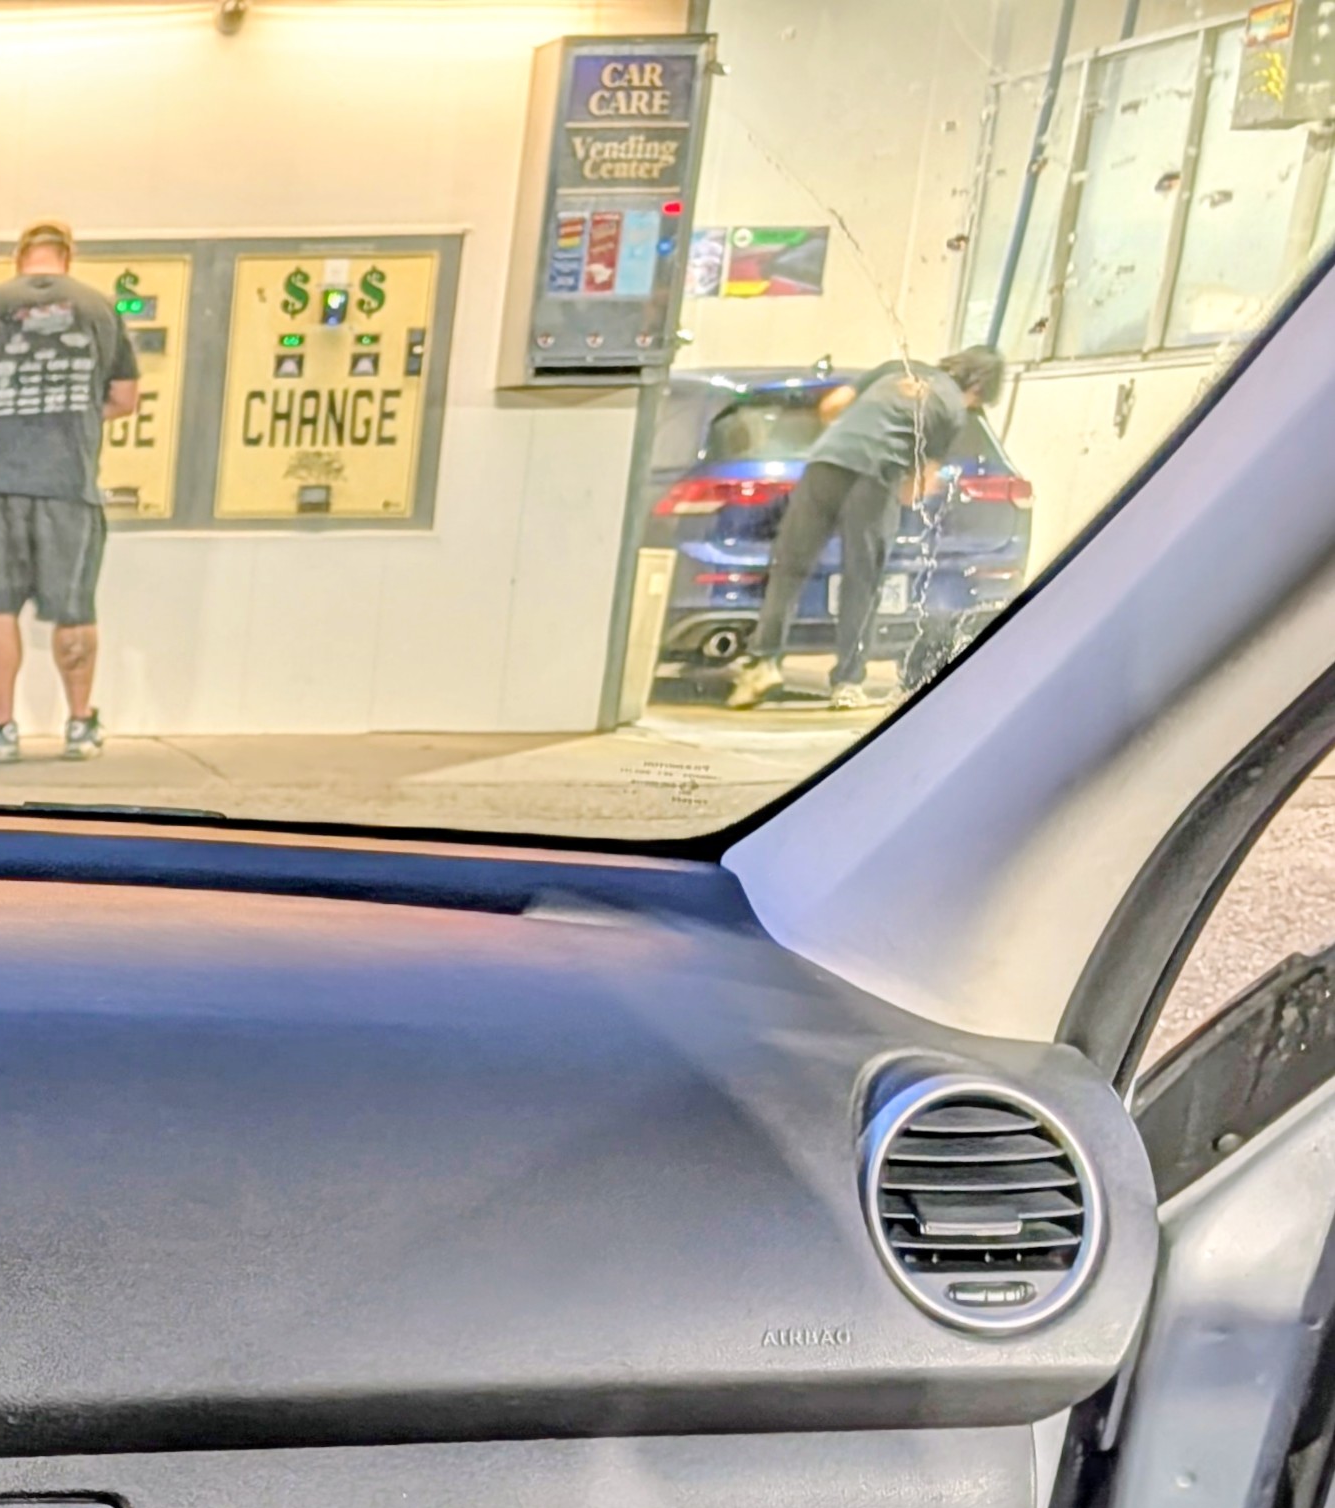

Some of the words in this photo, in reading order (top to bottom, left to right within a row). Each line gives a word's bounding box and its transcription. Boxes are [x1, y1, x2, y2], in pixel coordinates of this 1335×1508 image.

[601, 62, 664, 88] CAR
[589, 89, 671, 116] CARE
[572, 135, 679, 165] Vending
[583, 160, 662, 180] Center
[242, 388, 403, 447] CHANGE
[761, 1328, 852, 1347] AIRBAG
